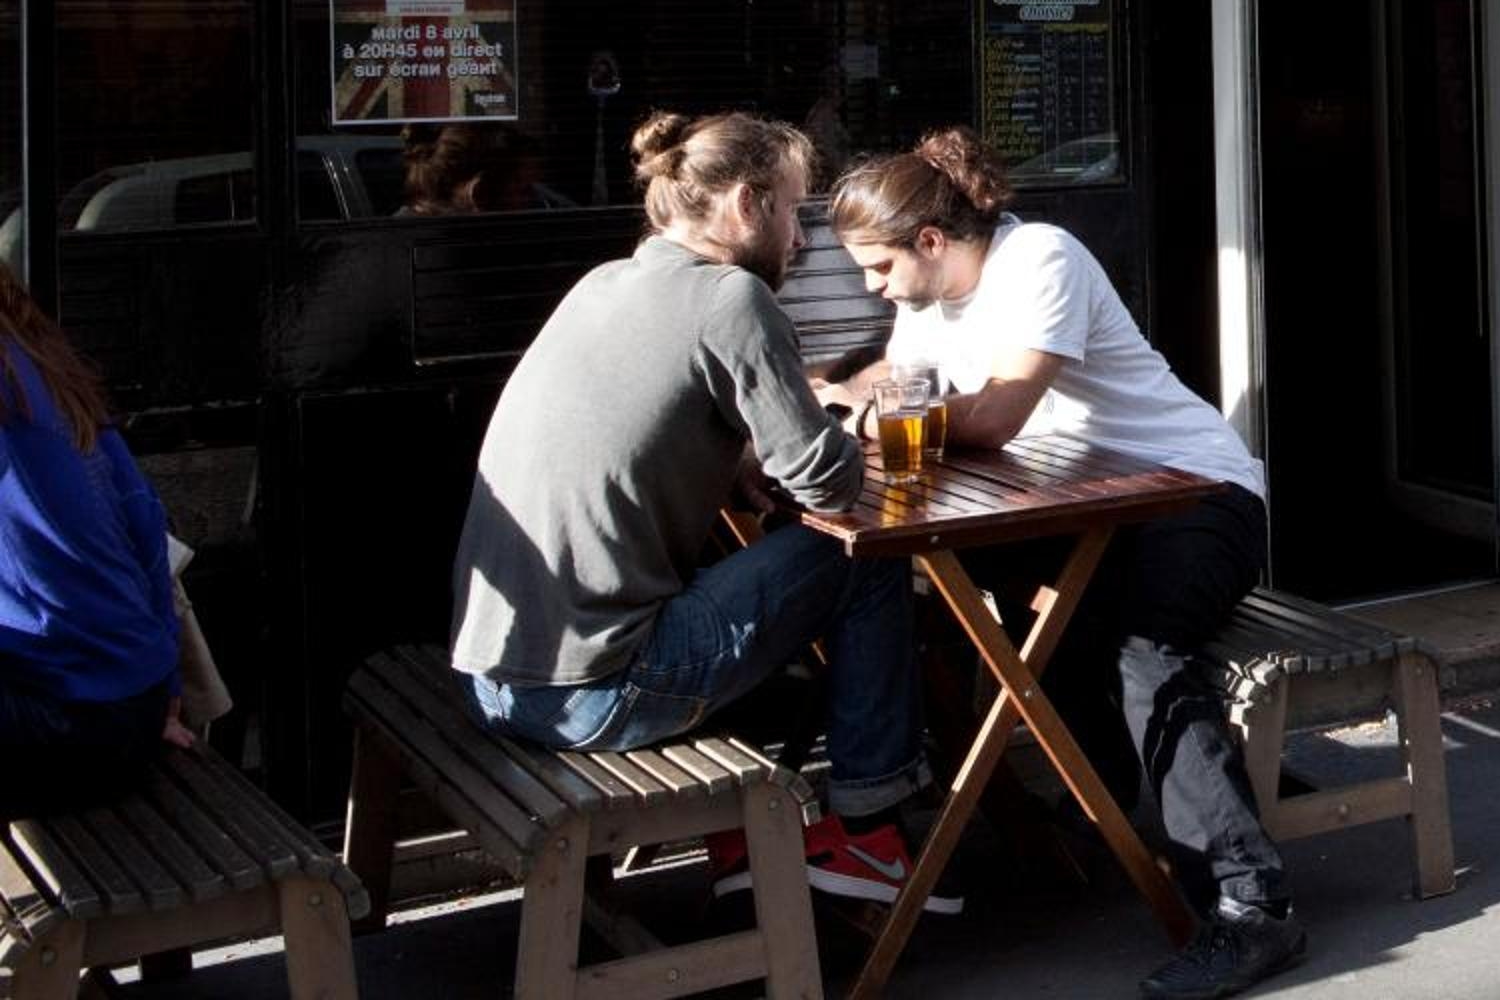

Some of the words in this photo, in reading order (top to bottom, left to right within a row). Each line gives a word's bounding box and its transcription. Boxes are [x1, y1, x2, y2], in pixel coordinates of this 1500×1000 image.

[425, 24, 437, 40] 8
[443, 24, 480, 40] avril
[341, 43, 355, 59] à
[359, 42, 417, 58] 20H45
[450, 42, 503, 58] direct
[353, 63, 384, 78] sur
